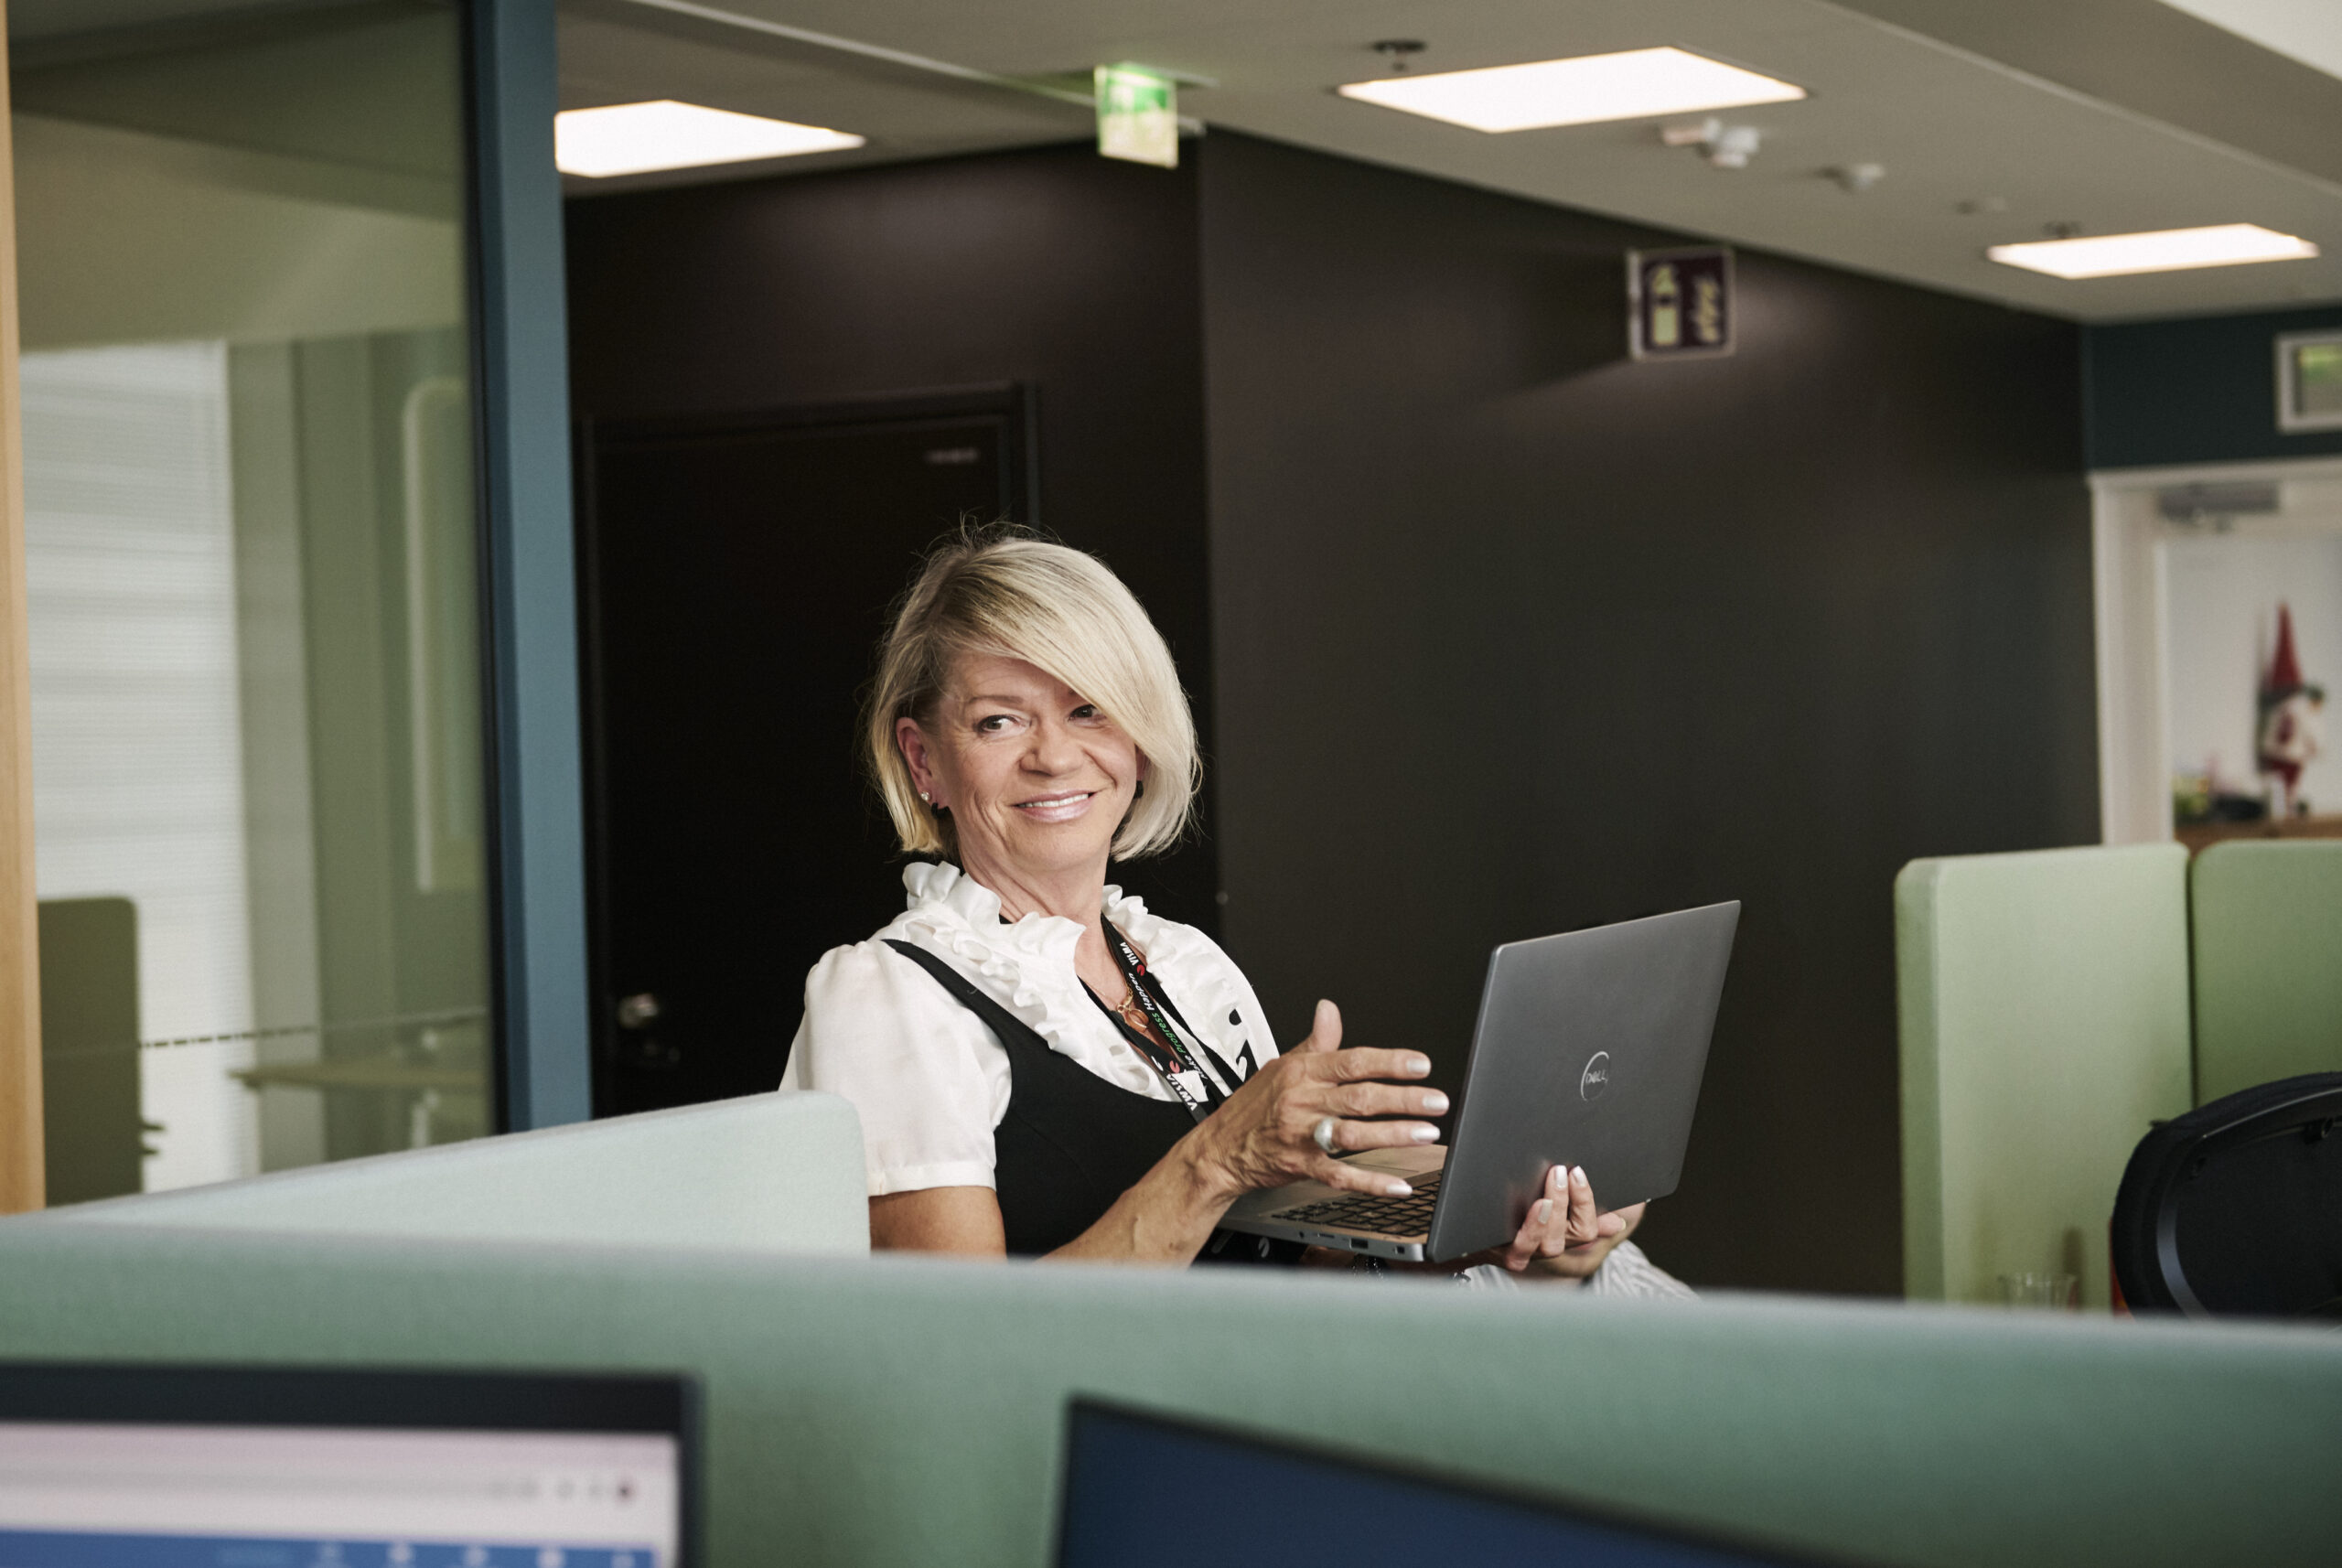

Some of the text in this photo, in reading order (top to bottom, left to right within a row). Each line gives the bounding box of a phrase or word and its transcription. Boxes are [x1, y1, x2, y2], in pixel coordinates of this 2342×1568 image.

[1120, 941, 1140, 966] VISMA
[1128, 972, 1209, 1079] Make Progress Happen
[1166, 1073, 1198, 1112] VISMA
